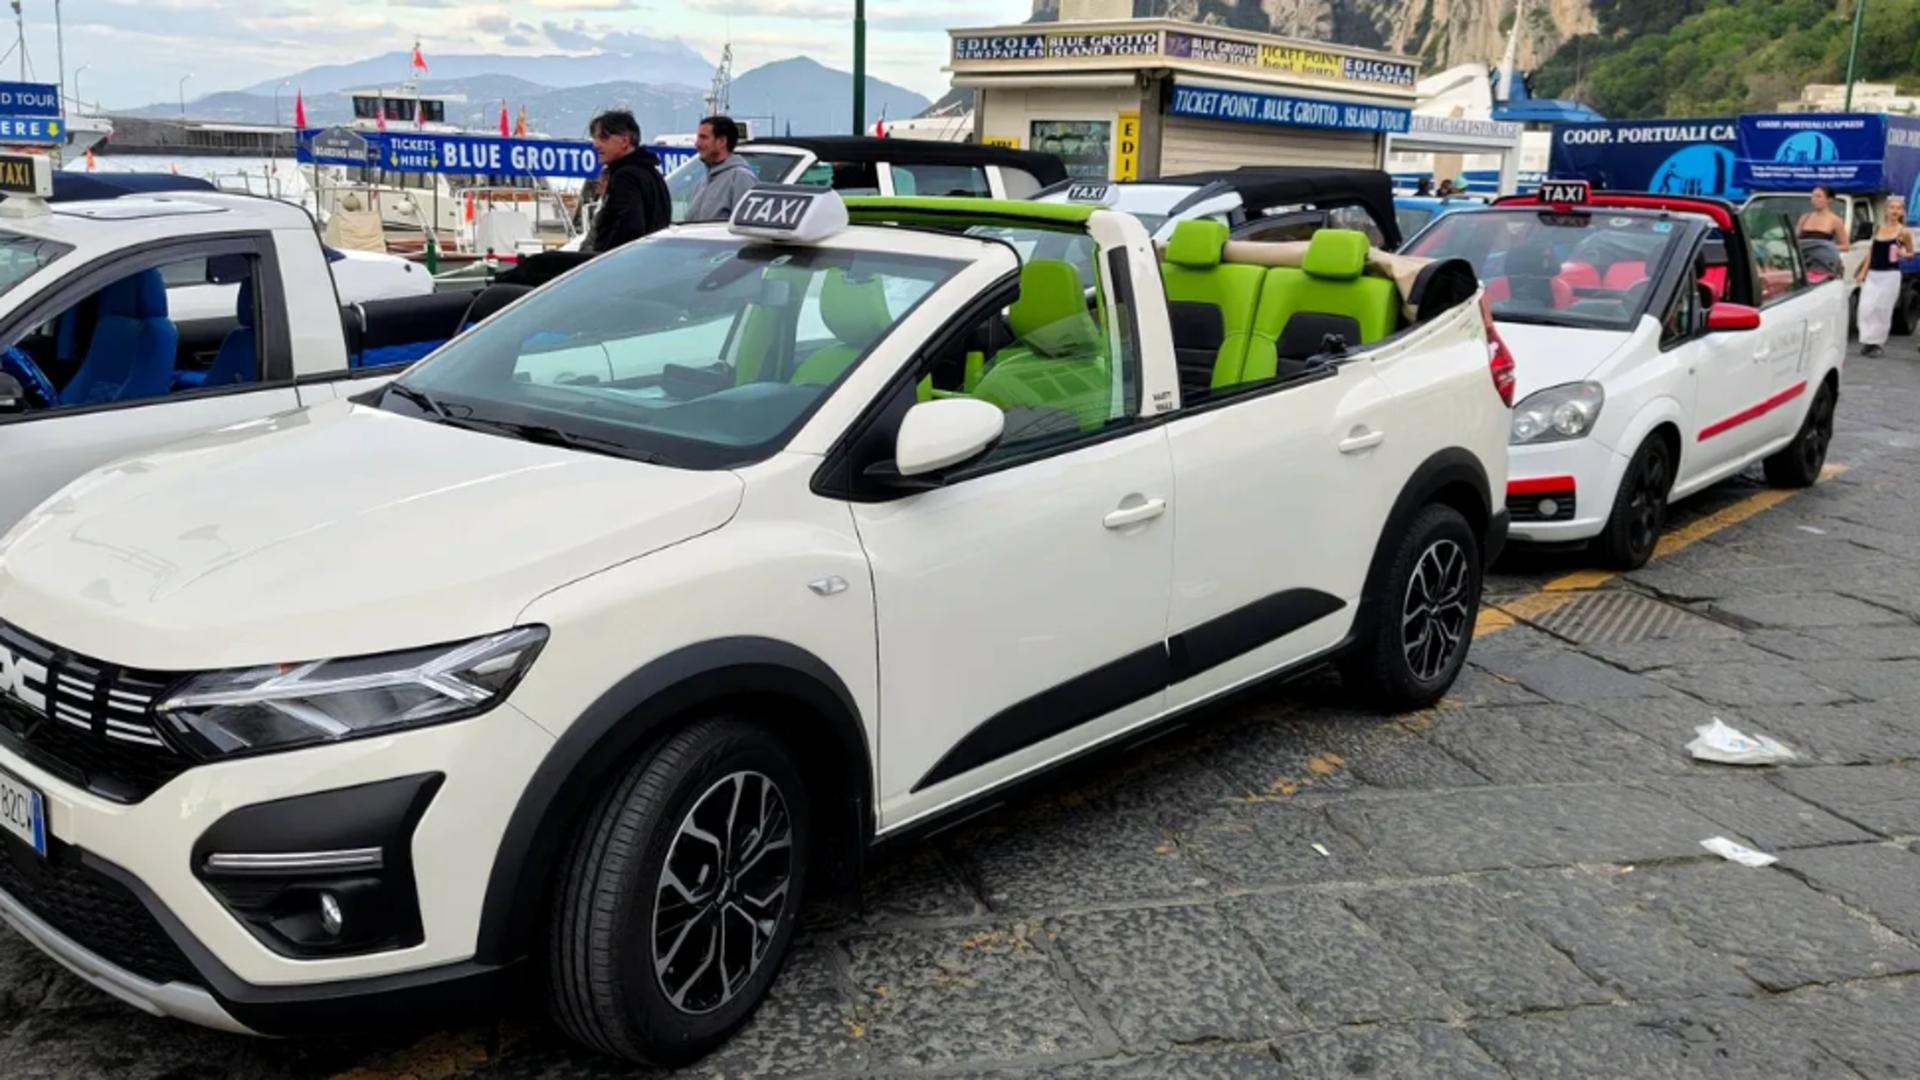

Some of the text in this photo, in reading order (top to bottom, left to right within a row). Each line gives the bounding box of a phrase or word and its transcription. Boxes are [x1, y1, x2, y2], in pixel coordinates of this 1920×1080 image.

[957, 37, 1044, 50] EDICOLA
[1050, 36, 1086, 47] BLUE
[1090, 33, 1156, 46] GROTTO
[1191, 38, 1216, 51] BLUE
[1218, 41, 1256, 55] GROTTO
[956, 49, 1044, 59] NEWSPAPERS
[1050, 45, 1156, 57] ISLAND TOUR
[1262, 45, 1341, 65] TICKET POINT
[1344, 59, 1413, 78] EDICOLA
[16, 92, 55, 107] TOUR
[1175, 90, 1217, 114] TICKET
[1264, 99, 1290, 121] BLUE
[1345, 107, 1379, 129] ISLAND
[1563, 128, 1613, 144] COOP.
[1617, 126, 1707, 143] PORTUALI
[390, 138, 436, 151] TICKETS
[401, 155, 428, 167] HERE
[443, 142, 501, 168] BLUE
[511, 146, 596, 172] GROTTO
[1071, 186, 1106, 199] TAXI
[1543, 186, 1584, 201] TAXI
[743, 196, 805, 225] TAXI
